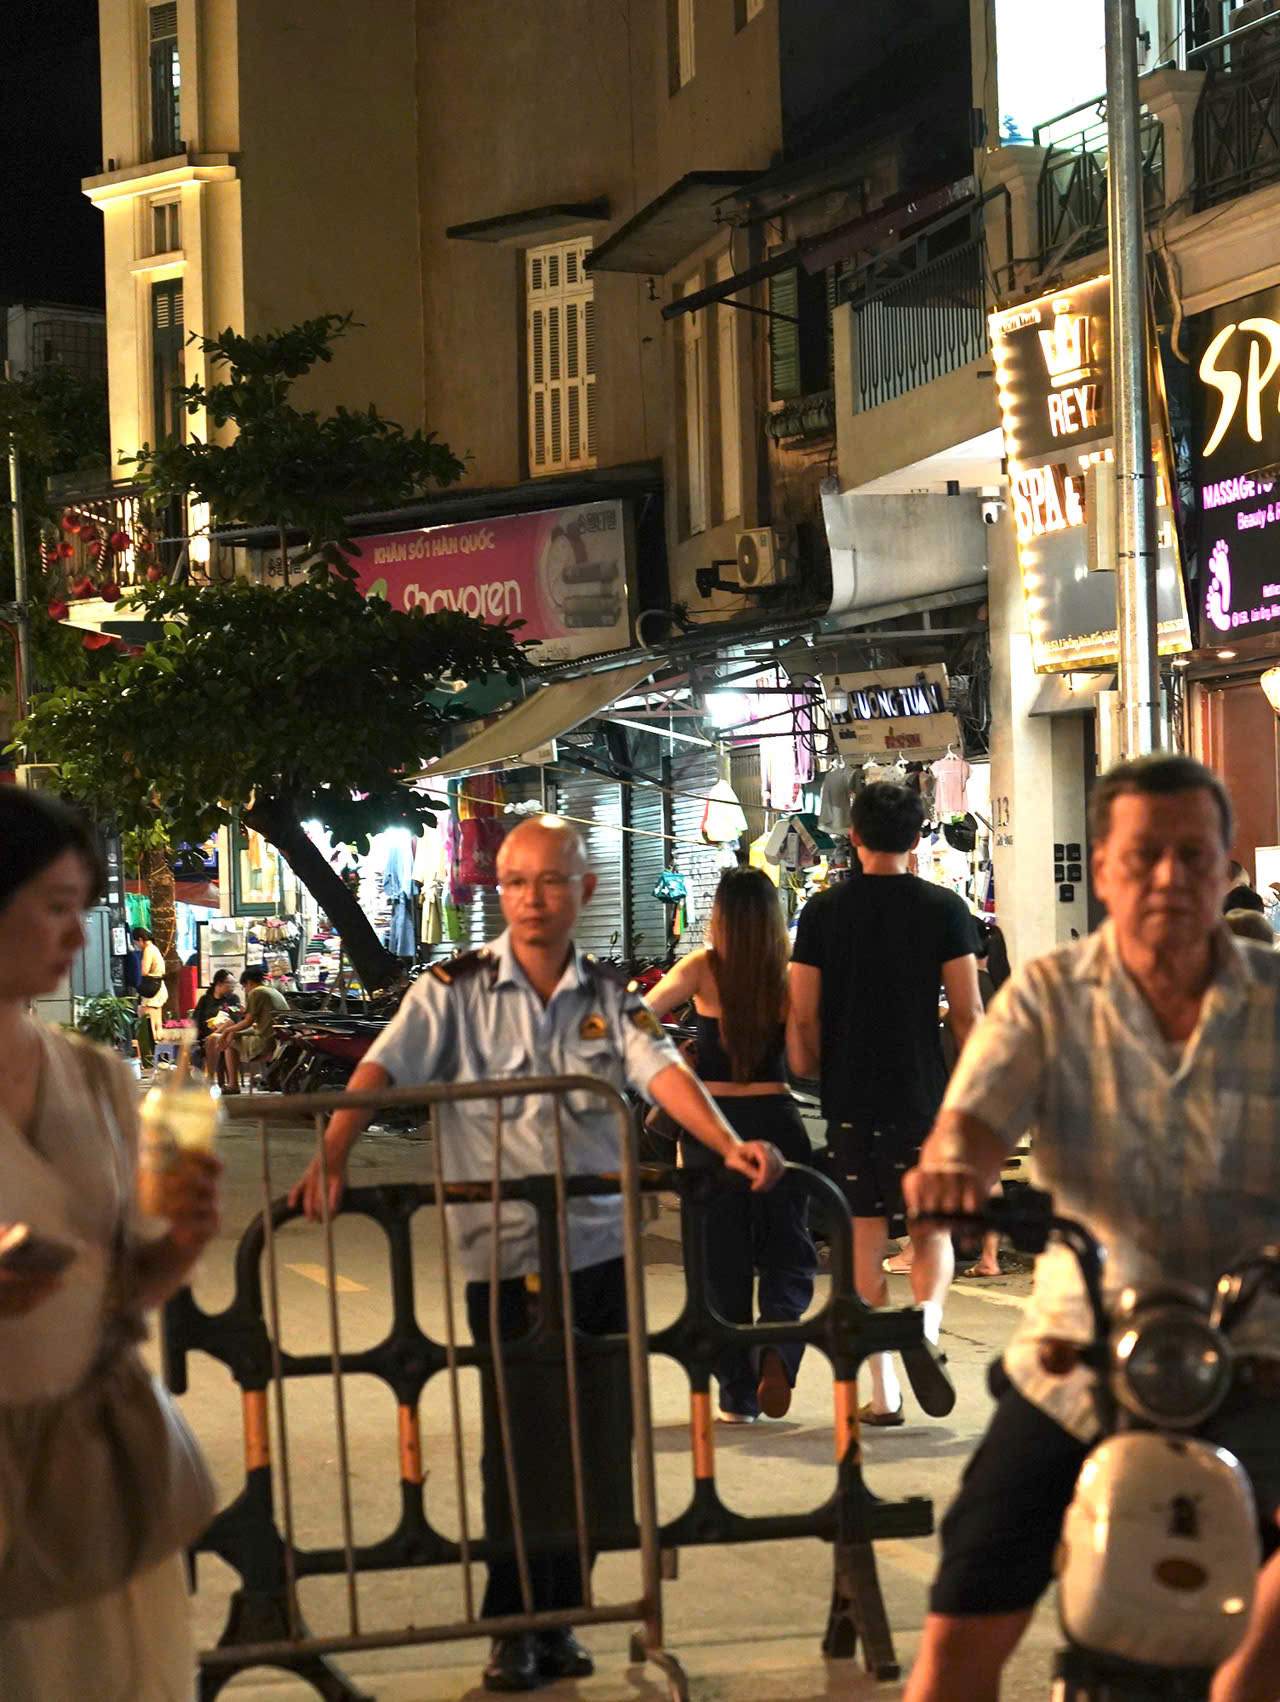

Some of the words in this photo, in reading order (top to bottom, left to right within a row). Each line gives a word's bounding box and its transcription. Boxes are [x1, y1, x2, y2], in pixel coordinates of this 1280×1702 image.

[1047, 384, 1096, 437] REY
[1012, 464, 1066, 541] SPA
[1202, 474, 1257, 510] MASSAGE
[1237, 508, 1267, 531] Beauty
[1267, 503, 1275, 523] &
